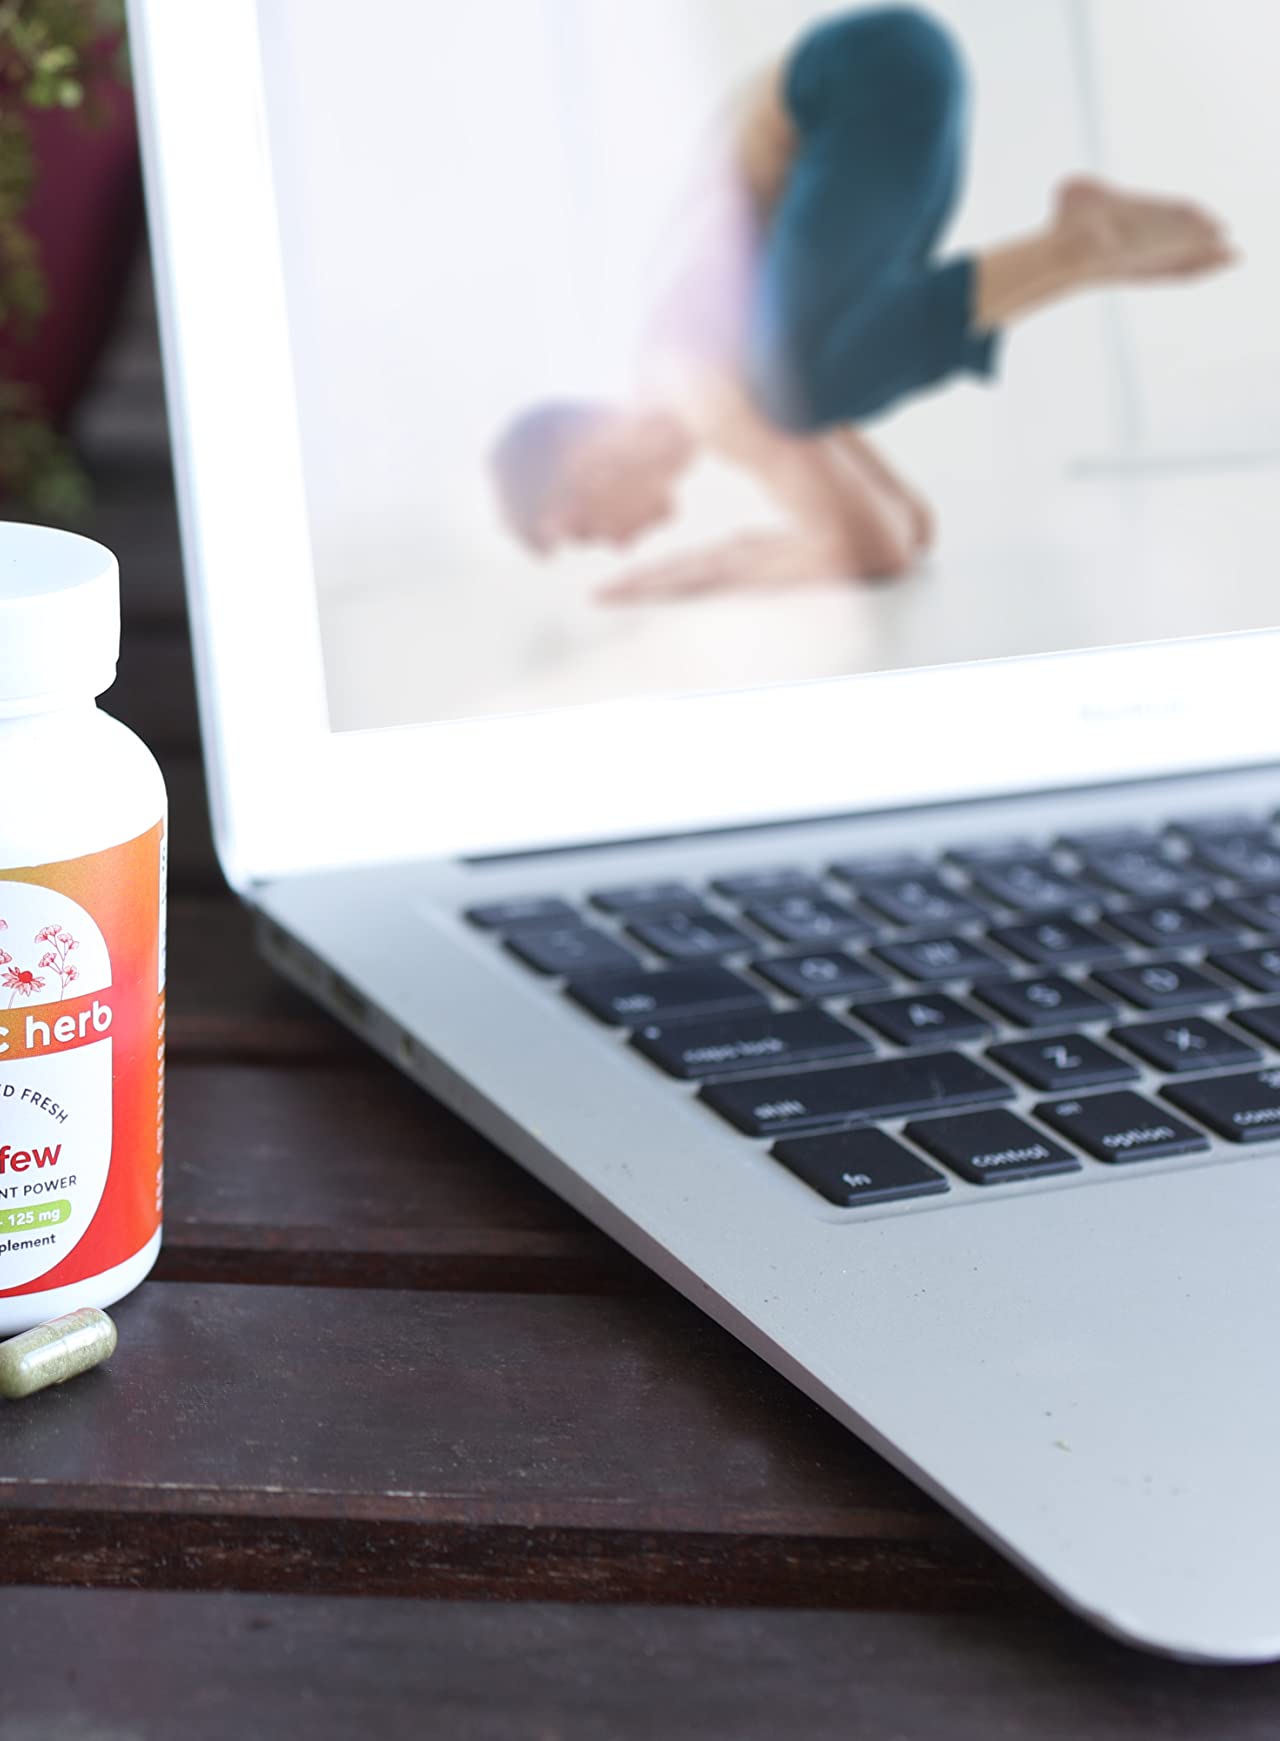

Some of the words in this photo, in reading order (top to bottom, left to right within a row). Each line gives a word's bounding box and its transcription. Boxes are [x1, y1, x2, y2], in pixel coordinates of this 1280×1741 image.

[25, 999, 113, 1049] herb
[1164, 1028, 1206, 1051] X
[1041, 1045, 1082, 1069] Z
[20, 1088, 70, 1125] FRESH
[1102, 1125, 1175, 1148] option
[971, 1143, 1050, 1168] control
[23, 1174, 77, 1197] POWER
[842, 1172, 871, 1187] fn
[8, 1211, 34, 1227] 125
[38, 1208, 61, 1222] mg
